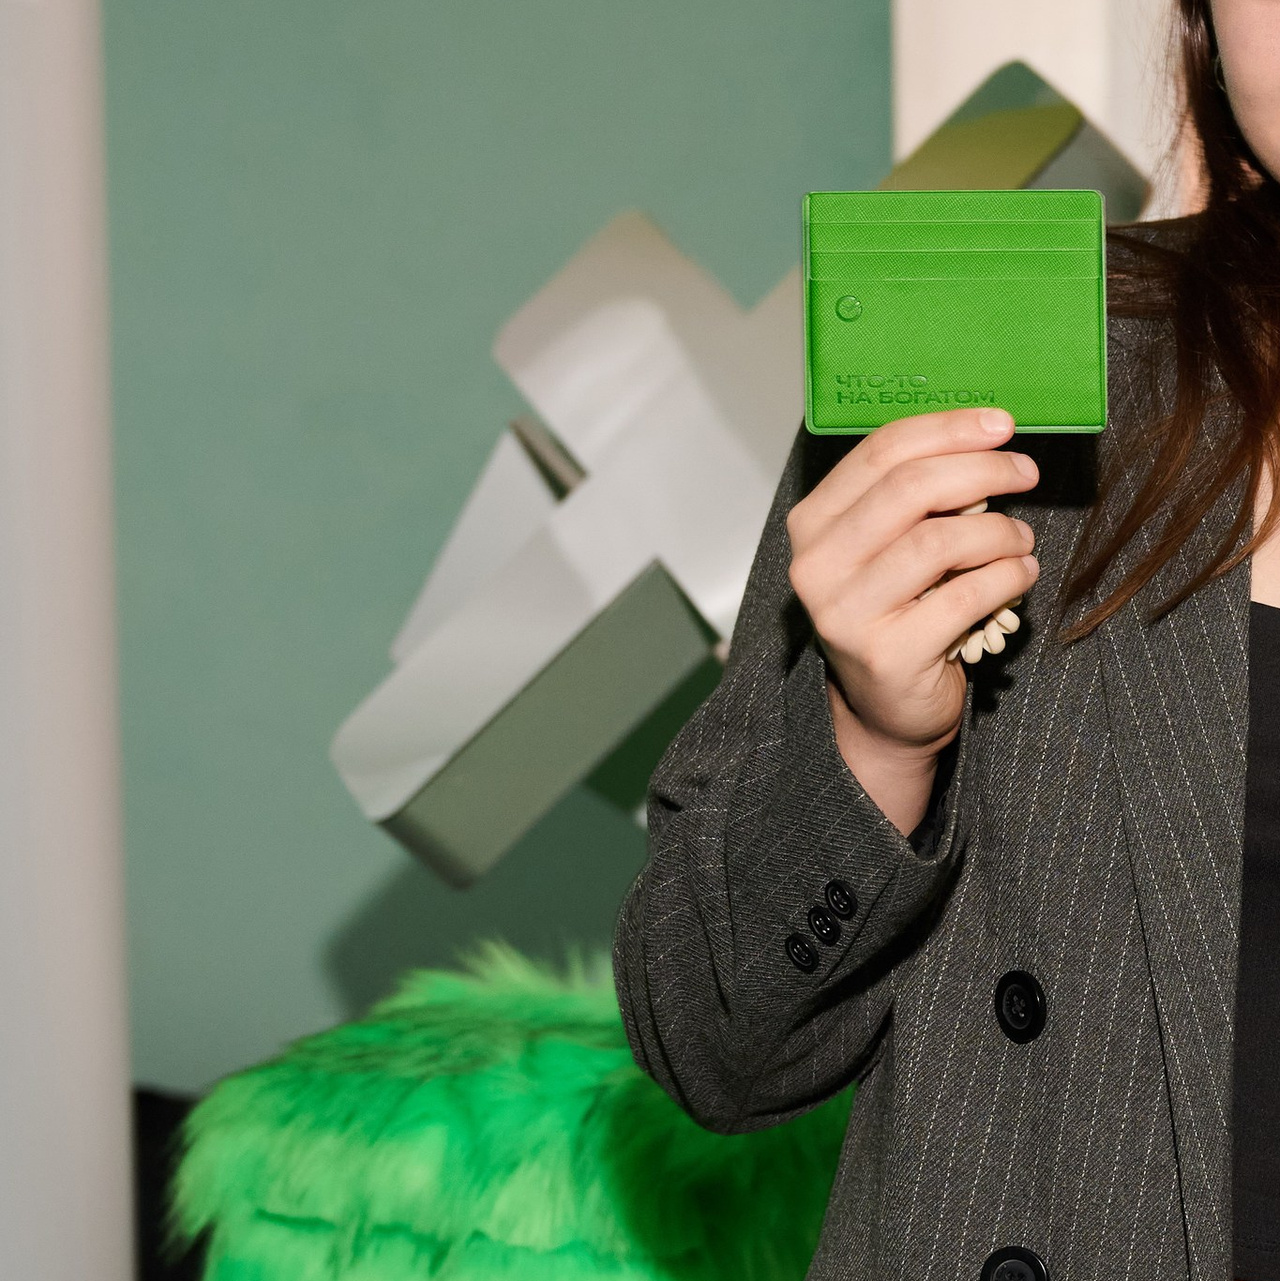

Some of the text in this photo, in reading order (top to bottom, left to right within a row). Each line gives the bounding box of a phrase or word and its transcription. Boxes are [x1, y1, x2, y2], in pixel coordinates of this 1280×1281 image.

[836, 374, 928, 388] ЧТО-ТО
[836, 391, 995, 404] НА БОГАТОМ
